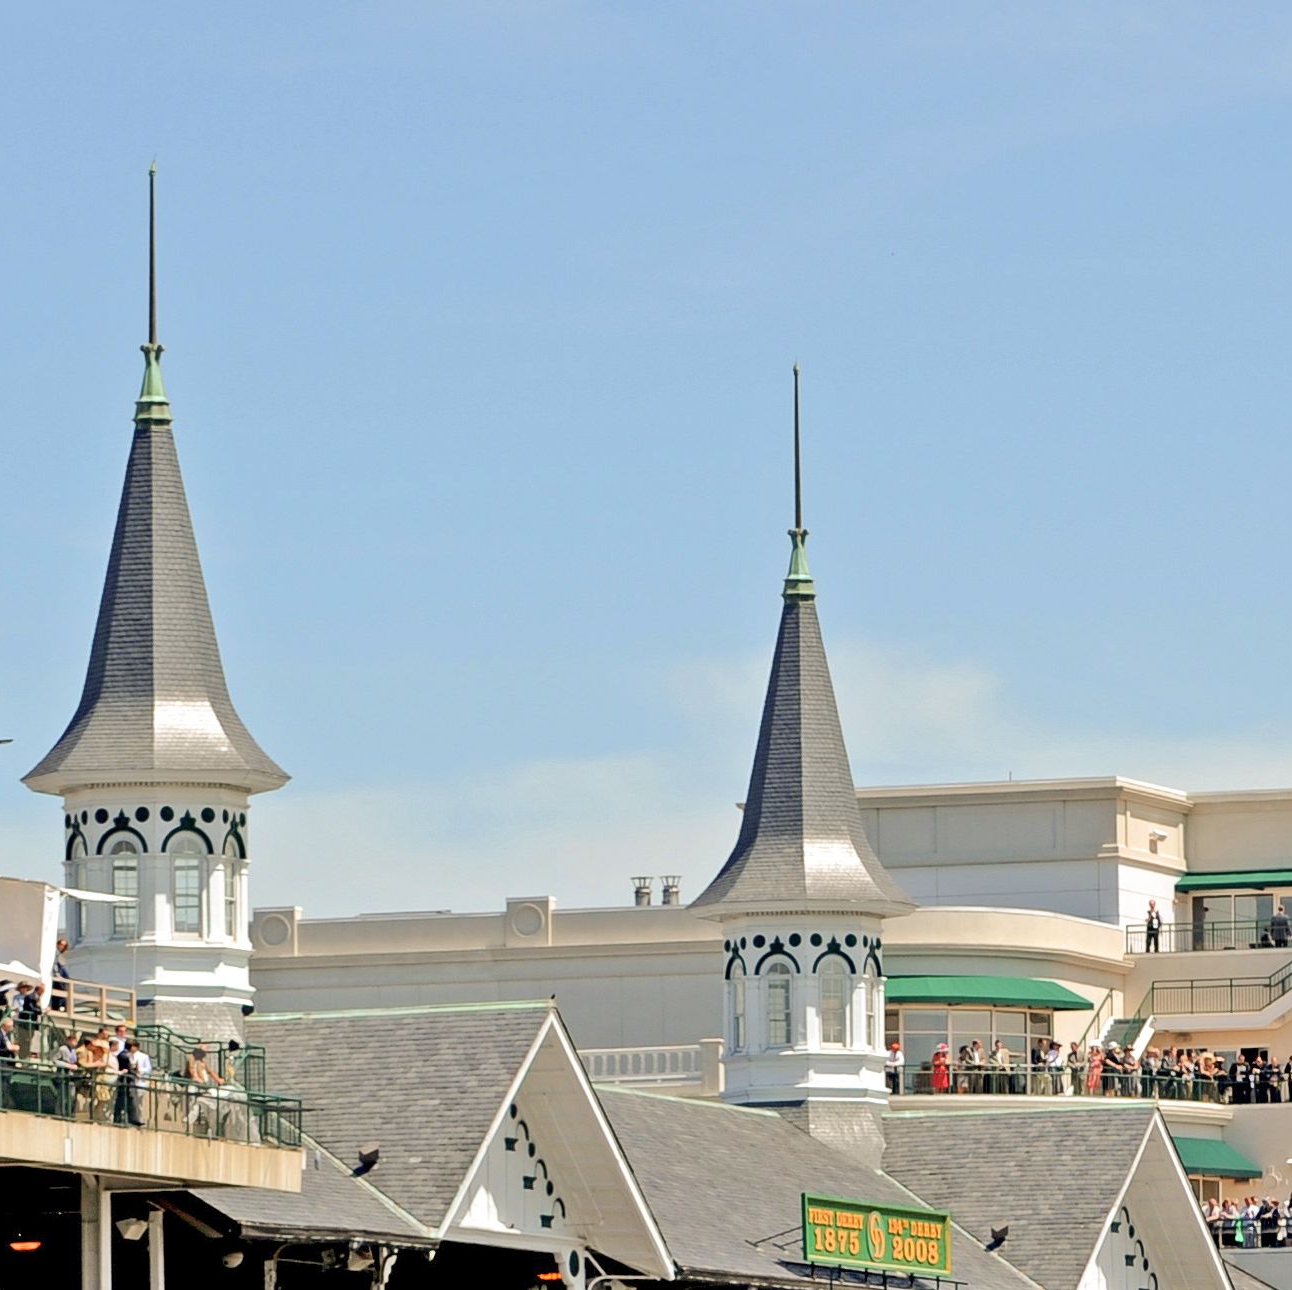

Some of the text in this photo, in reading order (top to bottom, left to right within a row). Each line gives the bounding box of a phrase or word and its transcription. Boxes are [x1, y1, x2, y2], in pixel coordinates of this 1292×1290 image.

[808, 1207, 864, 1230] FIRST DERBY
[910, 1220, 943, 1239] DERBY
[814, 1227, 861, 1255] 1875
[892, 1235, 939, 1265] 2008
